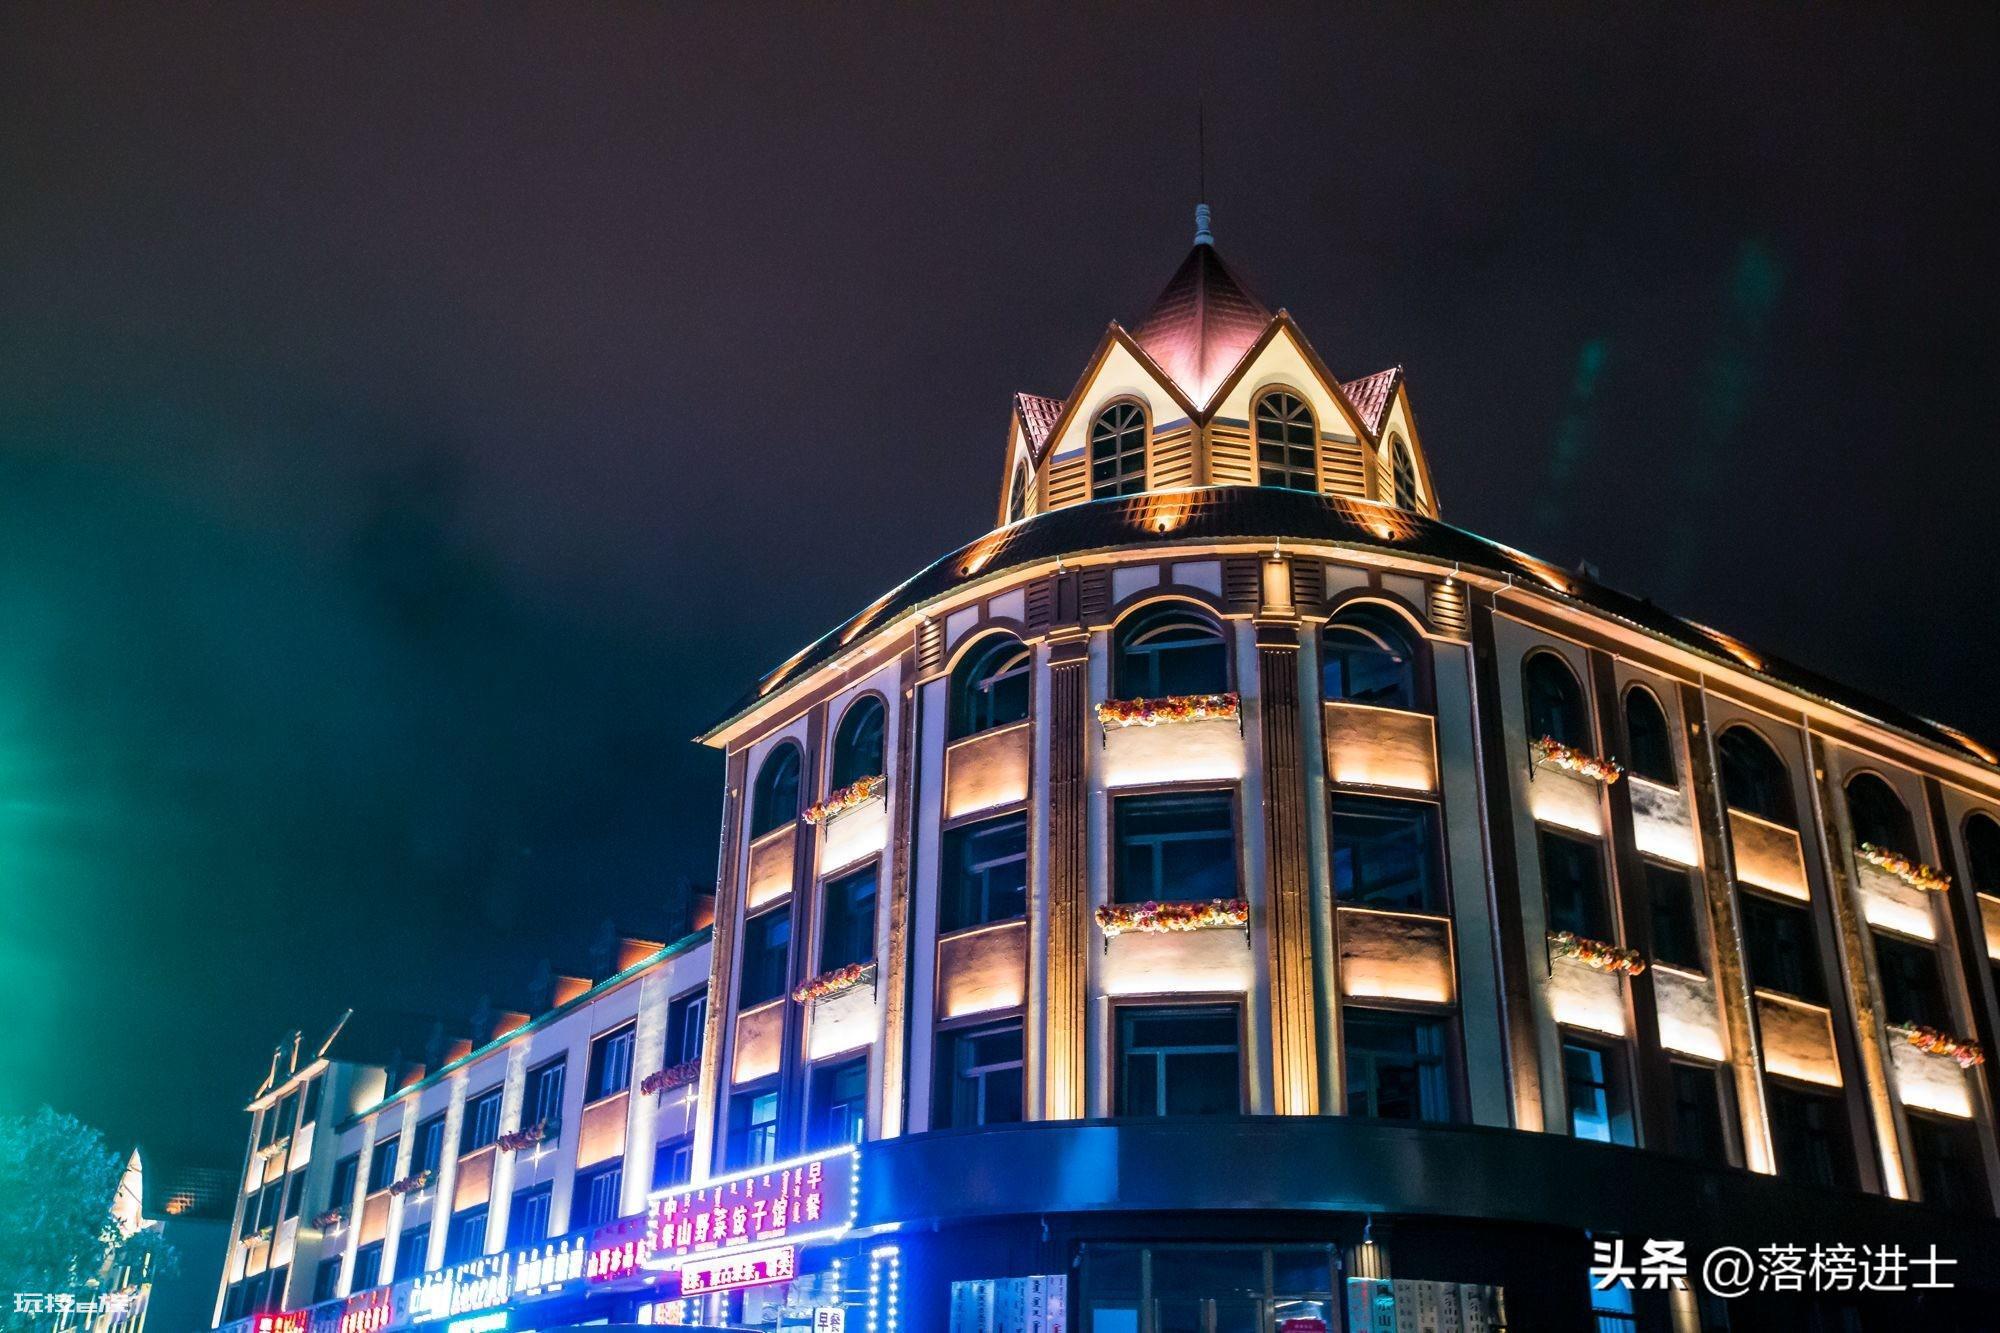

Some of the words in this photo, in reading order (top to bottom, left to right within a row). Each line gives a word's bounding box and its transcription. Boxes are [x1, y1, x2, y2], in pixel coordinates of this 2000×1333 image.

[806, 1162, 822, 1221] 早餐
[676, 1198, 789, 1246] 山野菜饺子馆
